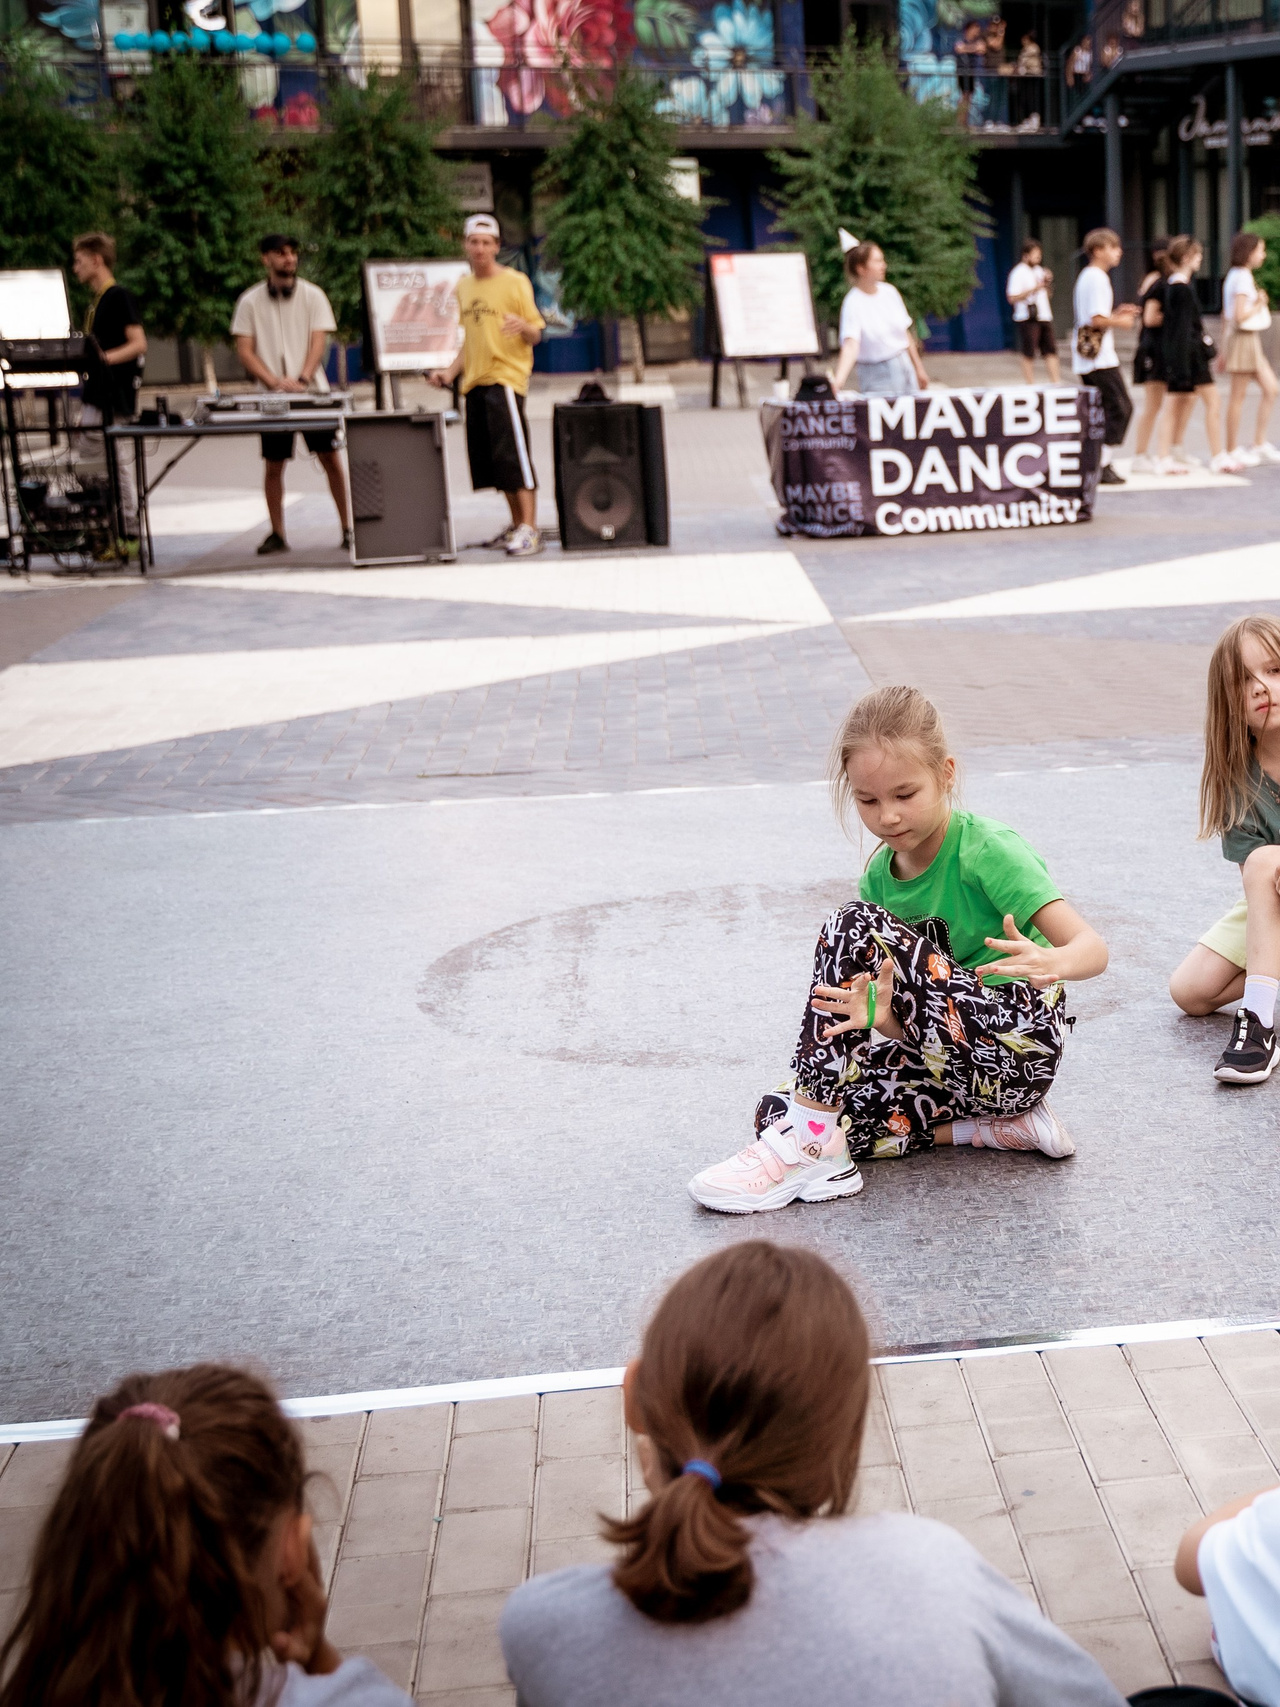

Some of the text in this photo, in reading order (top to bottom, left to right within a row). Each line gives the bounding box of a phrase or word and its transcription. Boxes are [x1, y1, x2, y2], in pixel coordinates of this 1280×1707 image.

[868, 387, 1082, 441] MAYBE
[781, 415, 857, 436] DANCE
[870, 441, 1083, 497] DANCE
[786, 481, 862, 502] MAYBE
[789, 502, 864, 523] DANCE
